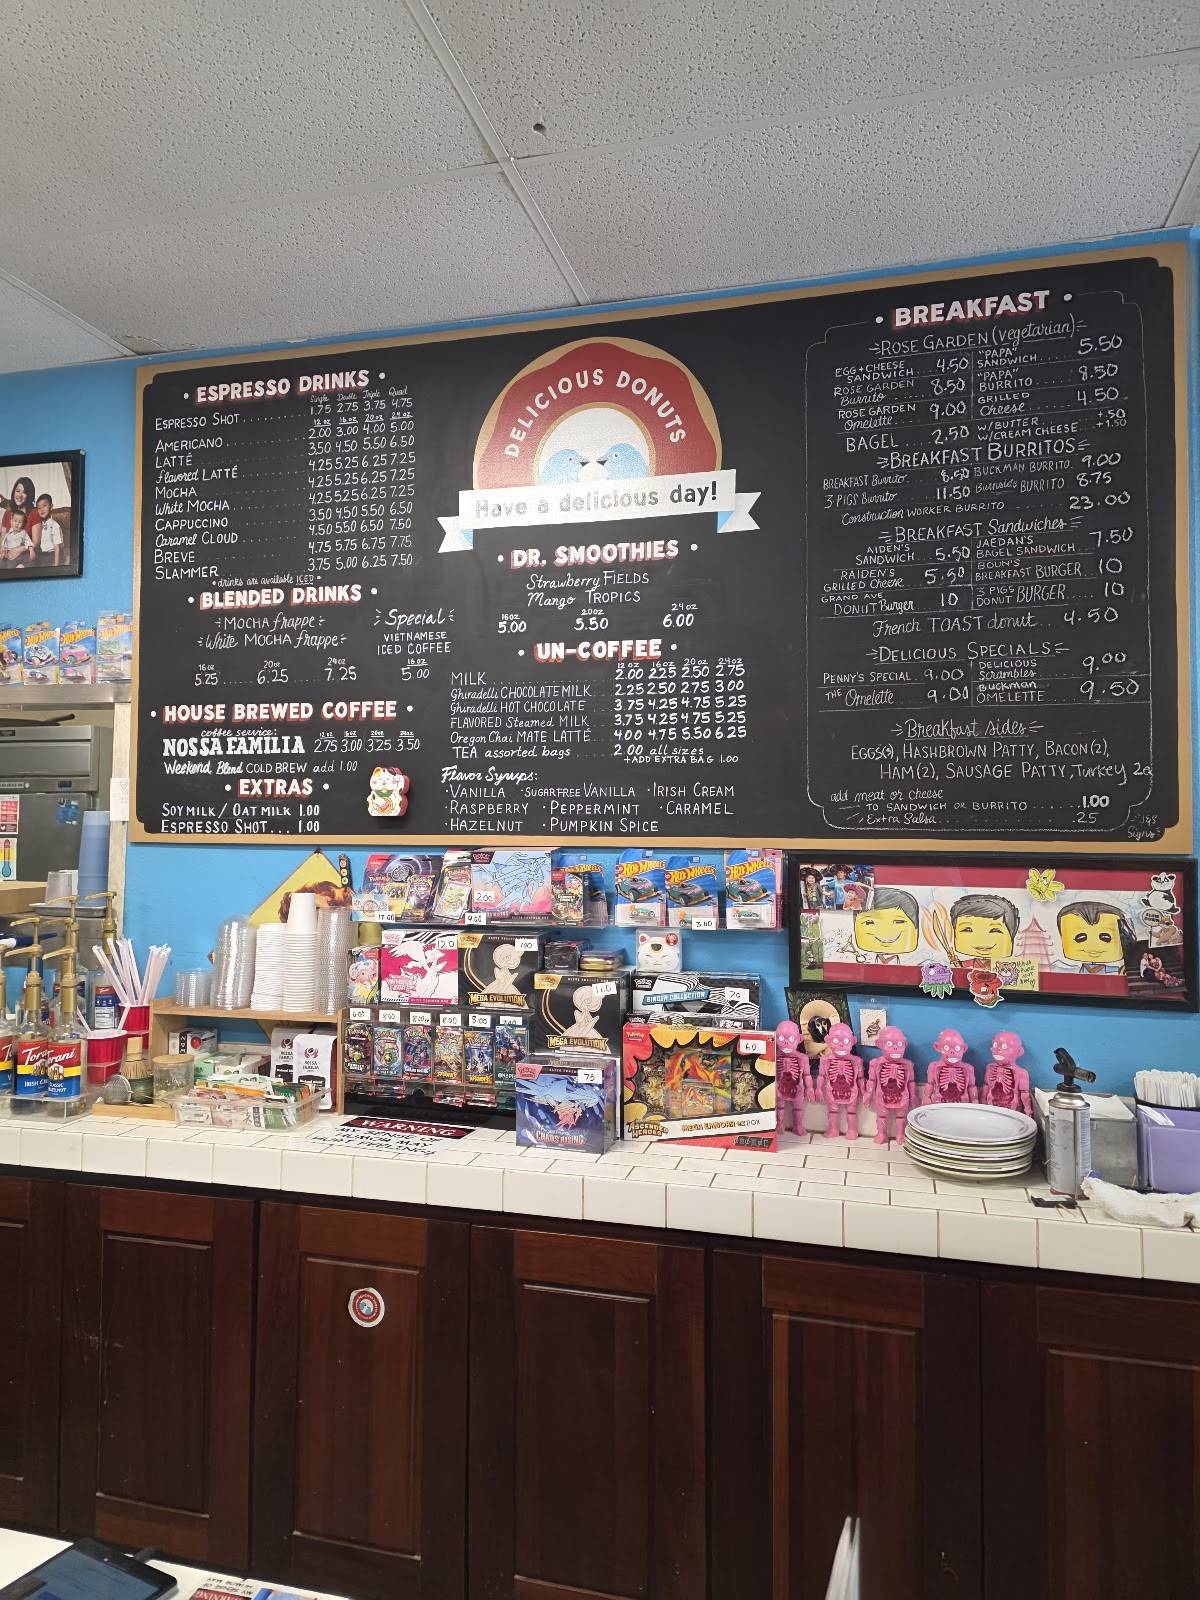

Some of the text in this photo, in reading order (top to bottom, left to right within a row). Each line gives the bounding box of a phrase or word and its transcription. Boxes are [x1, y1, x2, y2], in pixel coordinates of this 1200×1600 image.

[892, 290, 1050, 330] BREAKFAST
[880, 313, 1075, 356] ROSE GARDEN (vegetarian)
[196, 370, 370, 403] ESPRESSO DRINKS
[155, 397, 413, 430] ESPRESSO SHOT 1.75 2.75 3.75 4.75
[504, 368, 686, 459] DELICIOUS DONUTS
[155, 437, 223, 453] AMERICANO
[846, 426, 969, 452] BAGEL 2.50
[155, 453, 193, 469] LATTÉ
[890, 438, 1076, 470] BREAKFAST BURRITOS
[202, 465, 239, 481] LATTÉ
[155, 486, 197, 499] MOCHA
[474, 480, 717, 519] Have a delicious day!
[156, 499, 230, 516] White MOCHA
[842, 508, 904, 525] Construction
[907, 505, 951, 516] WORKER
[955, 501, 1004, 512] BURRITO
[155, 517, 228, 531] CAPPUCCINO
[895, 517, 1067, 542] BREAKFAST Sandwiches
[156, 532, 238, 547] Caramel CLOUD
[155, 551, 195, 564] BREVE
[511, 540, 679, 570] DR. SMOOTHIES
[155, 565, 219, 580] SLAMMER
[218, 577, 243, 587] drinks
[247, 577, 259, 585] are
[261, 575, 294, 584] available
[527, 572, 649, 591] Strawberry FIELDS
[200, 584, 362, 609] BLENDED DRINKS
[527, 591, 641, 608] Mango TROPICS
[224, 613, 315, 632] MOCHA frappe
[385, 609, 446, 630] Special
[498, 614, 695, 633] 5.00 5.50 6.00
[872, 607, 1118, 637] French TOAST donut 4.50
[205, 632, 338, 650] White MOCHA frappe
[384, 631, 447, 642] VIETNAMESE
[377, 642, 451, 655] ICED COFFEE
[534, 639, 662, 664] UN-COFFEE
[879, 642, 1051, 663] DELICIOUS SPECIALS
[401, 668, 430, 681] 5.00
[451, 672, 486, 685] MILK
[823, 669, 964, 683] PENNY'S SPECIAL 9.00
[164, 701, 397, 722] HOUSE BREWED COFFEE
[501, 701, 520, 713] HOT
[524, 700, 585, 713] CHOCOLATE
[451, 715, 590, 729] FLAVORED Steamed MILK
[905, 719, 1027, 738] Breakfast sides
[451, 729, 591, 744] Oregon Chai MATE LATTÉ
[163, 736, 305, 757] NOSSA FAMILIA
[453, 745, 571, 759] TEA assorted bags
[903, 744, 987, 759] HASHBROWN
[992, 741, 1039, 759] PATTY,
[441, 766, 483, 783] Flavor
[880, 763, 940, 781] HAM(2),
[946, 764, 1012, 779] SAUSAGE
[237, 778, 314, 798] EXTRAS
[450, 785, 505, 798] VANILLA
[583, 784, 635, 798] VANILLA
[653, 784, 686, 797] IRISH
[694, 783, 735, 797] CREAM
[831, 790, 851, 801] add
[854, 789, 886, 801] meat
[908, 788, 943, 800] cheese
[161, 803, 291, 817] SOY MILK OAT MILK
[450, 801, 734, 815] RASPBERRY PEPPERMINT CARAMEL
[866, 803, 879, 811] TO
[886, 801, 947, 811] SANDWICH
[972, 801, 1028, 811] BURRITO
[161, 820, 267, 834] ESPRESSO SHOT
[450, 819, 659, 832] HAZELNUT PUMPKIN SPICE
[867, 812, 936, 825] Extra Salsa
